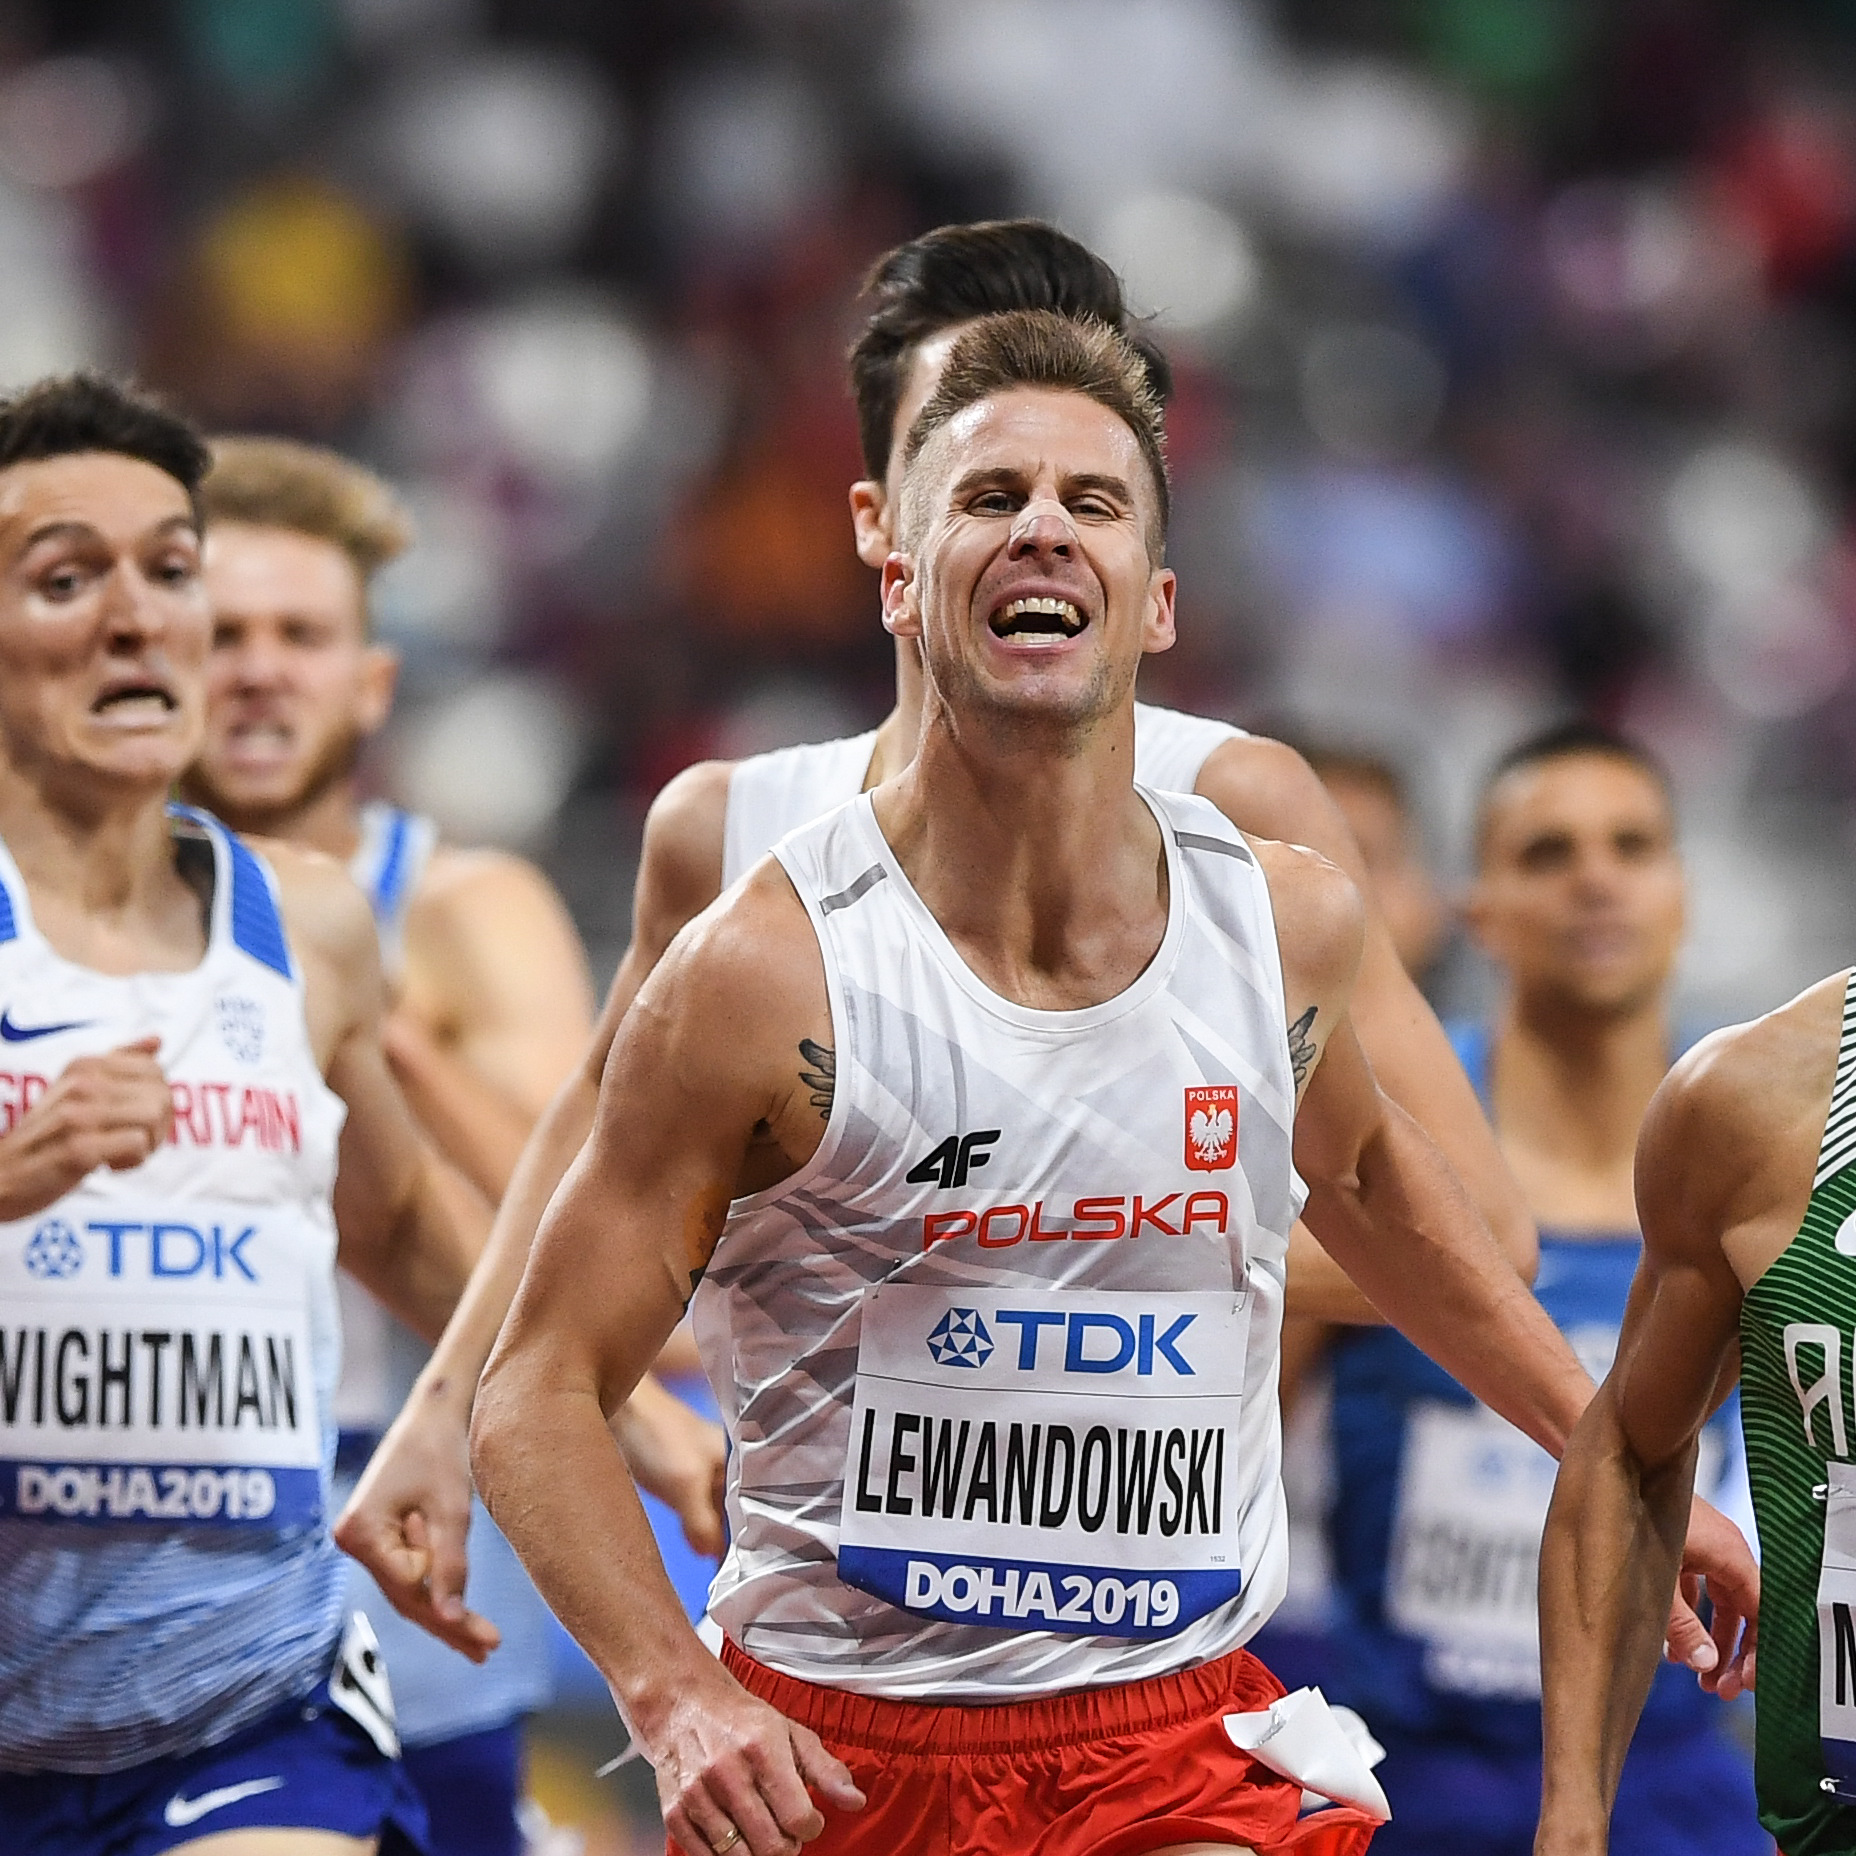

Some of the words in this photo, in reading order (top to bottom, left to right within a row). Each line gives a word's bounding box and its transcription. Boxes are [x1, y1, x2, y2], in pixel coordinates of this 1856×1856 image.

[164, 1080, 301, 1152] RITAIN
[1189, 1089, 1235, 1101] POLSKA
[906, 1129, 1001, 1188] 4F
[923, 1191, 1229, 1251] POLSKA
[88, 1222, 259, 1282] TDK
[996, 1311, 1199, 1376] TDK
[16, 1466, 276, 1519] DOHA2019
[855, 1408, 1225, 1536] LEWANDOWSKI
[905, 1560, 1180, 1627] DOHA2019
